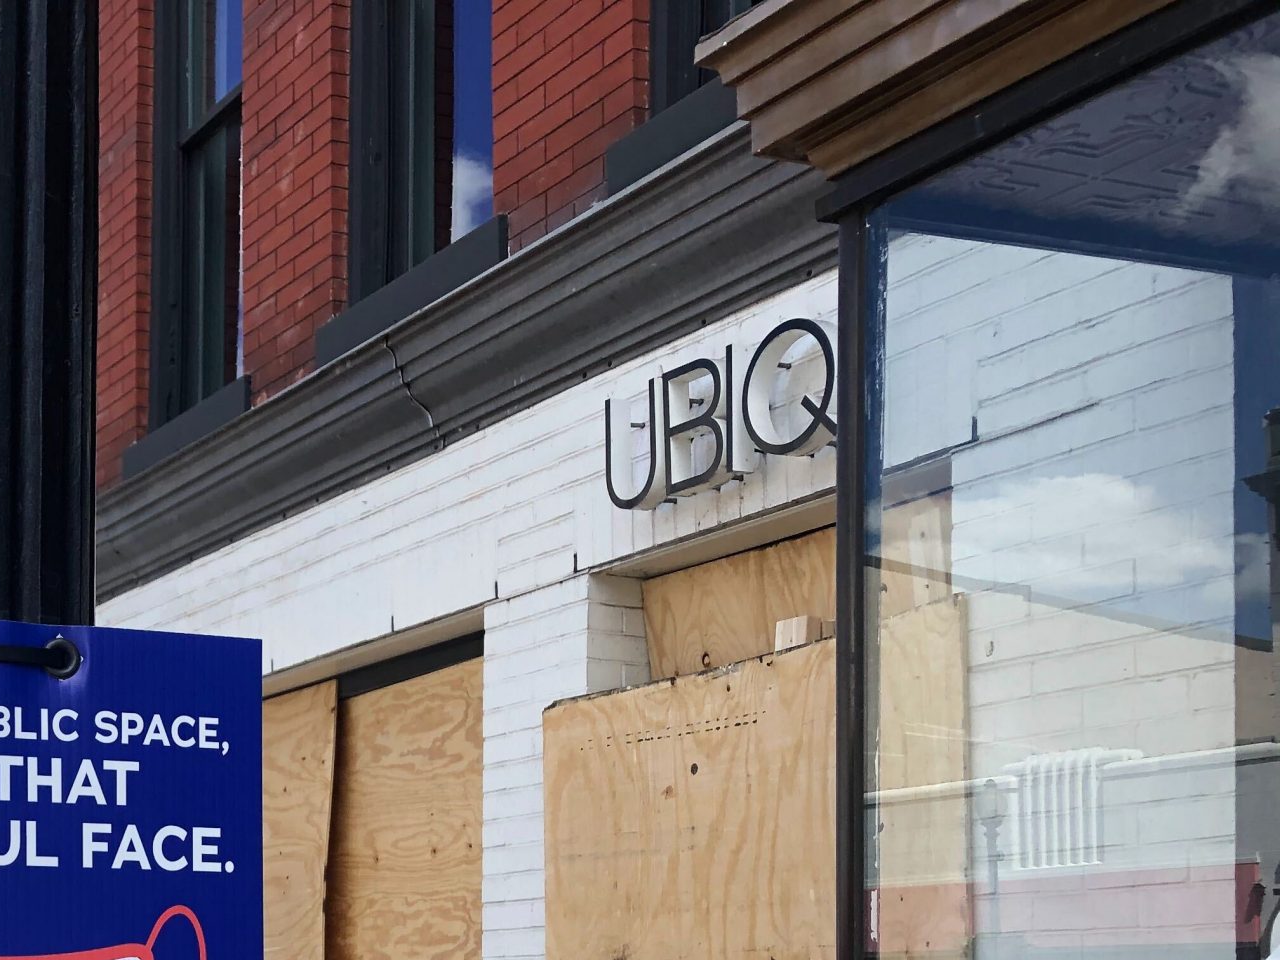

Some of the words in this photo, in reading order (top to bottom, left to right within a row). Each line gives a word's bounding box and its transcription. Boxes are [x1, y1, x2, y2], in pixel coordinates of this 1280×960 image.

[605, 318, 837, 509] UBIQ
[95, 711, 229, 755] SPACE,
[83, 823, 234, 873] FACE.
